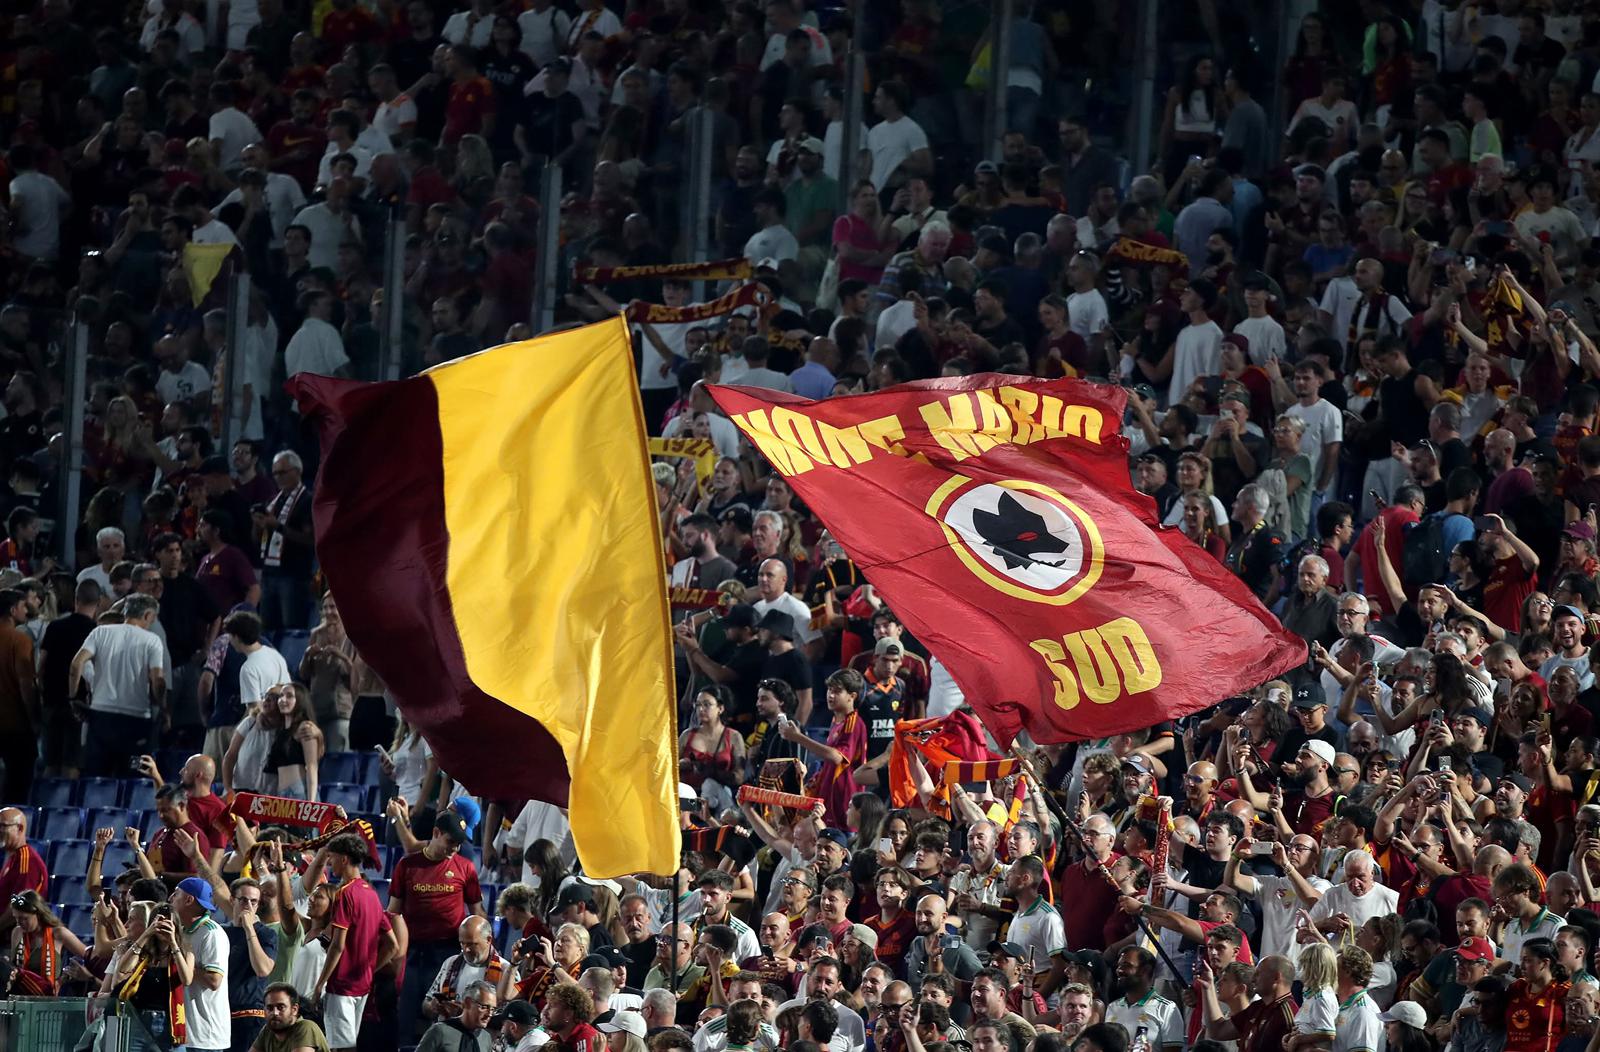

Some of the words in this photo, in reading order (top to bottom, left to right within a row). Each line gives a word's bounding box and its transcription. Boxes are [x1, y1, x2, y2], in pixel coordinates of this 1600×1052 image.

[919, 386, 1104, 462] MARIO
[663, 439, 715, 457] 1927
[671, 587, 708, 604] MAI
[1029, 617, 1162, 710] SUD
[872, 718, 895, 729] INA
[413, 883, 455, 893] digitalbits
